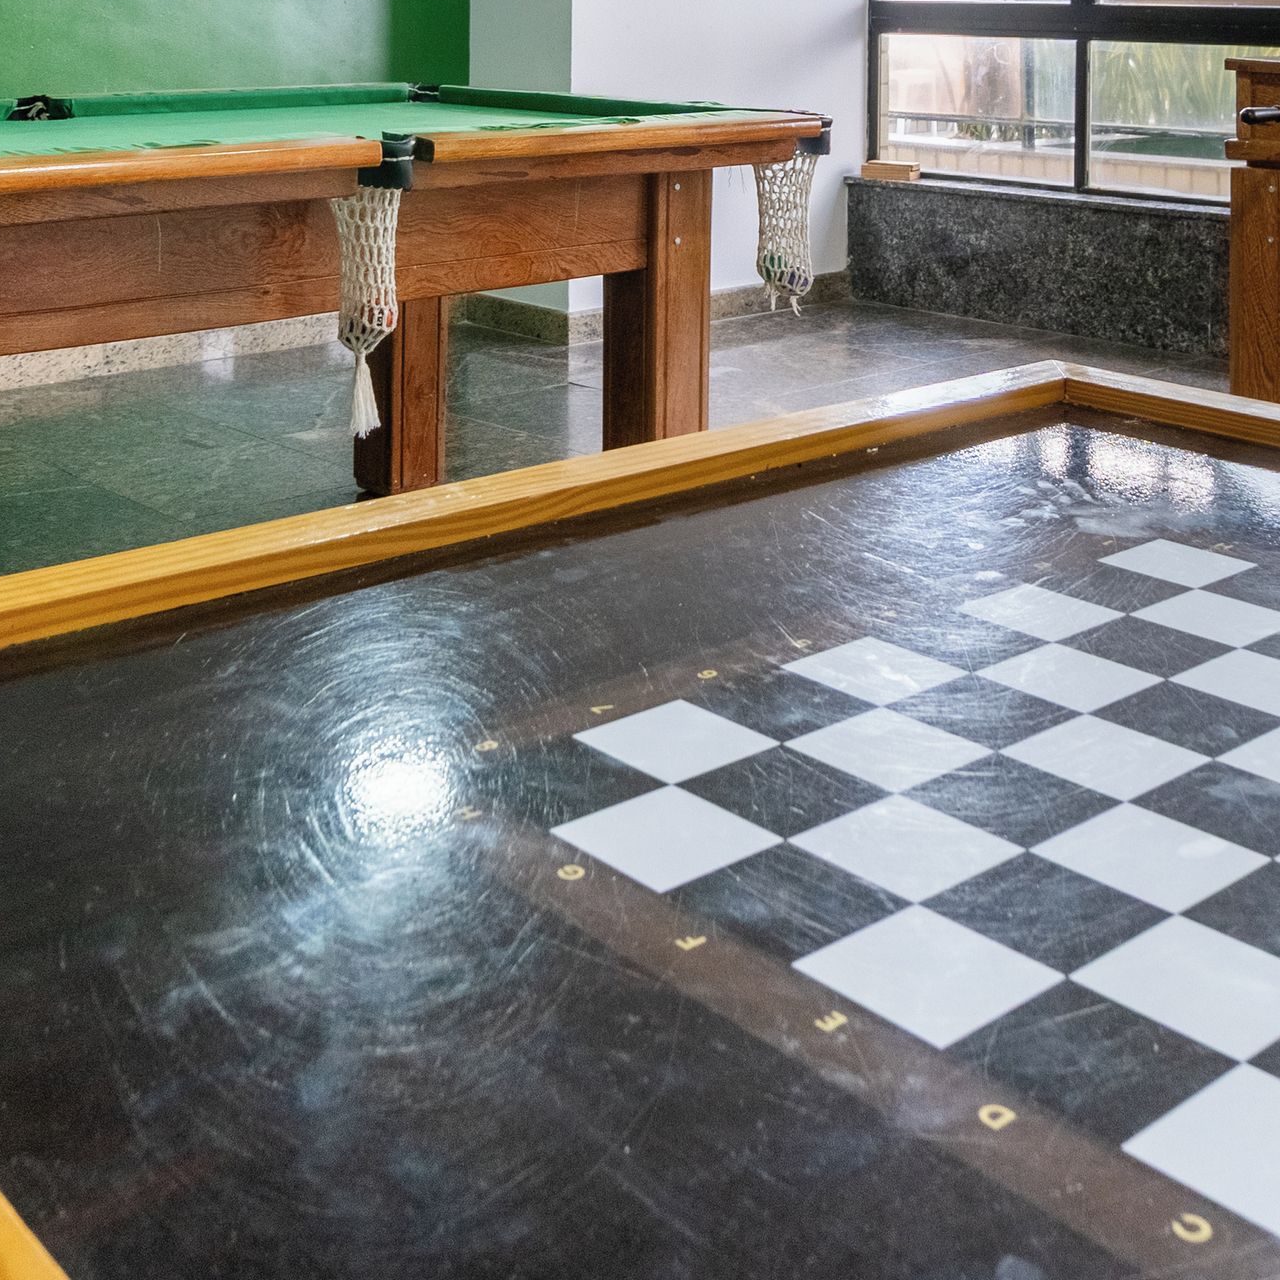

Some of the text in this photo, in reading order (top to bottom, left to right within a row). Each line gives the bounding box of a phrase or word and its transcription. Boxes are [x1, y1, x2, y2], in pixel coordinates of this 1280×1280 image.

[674, 935, 708, 951] F
[814, 1010, 849, 1033] E
[977, 1103, 1018, 1131] D
[1171, 1212, 1214, 1244] C
